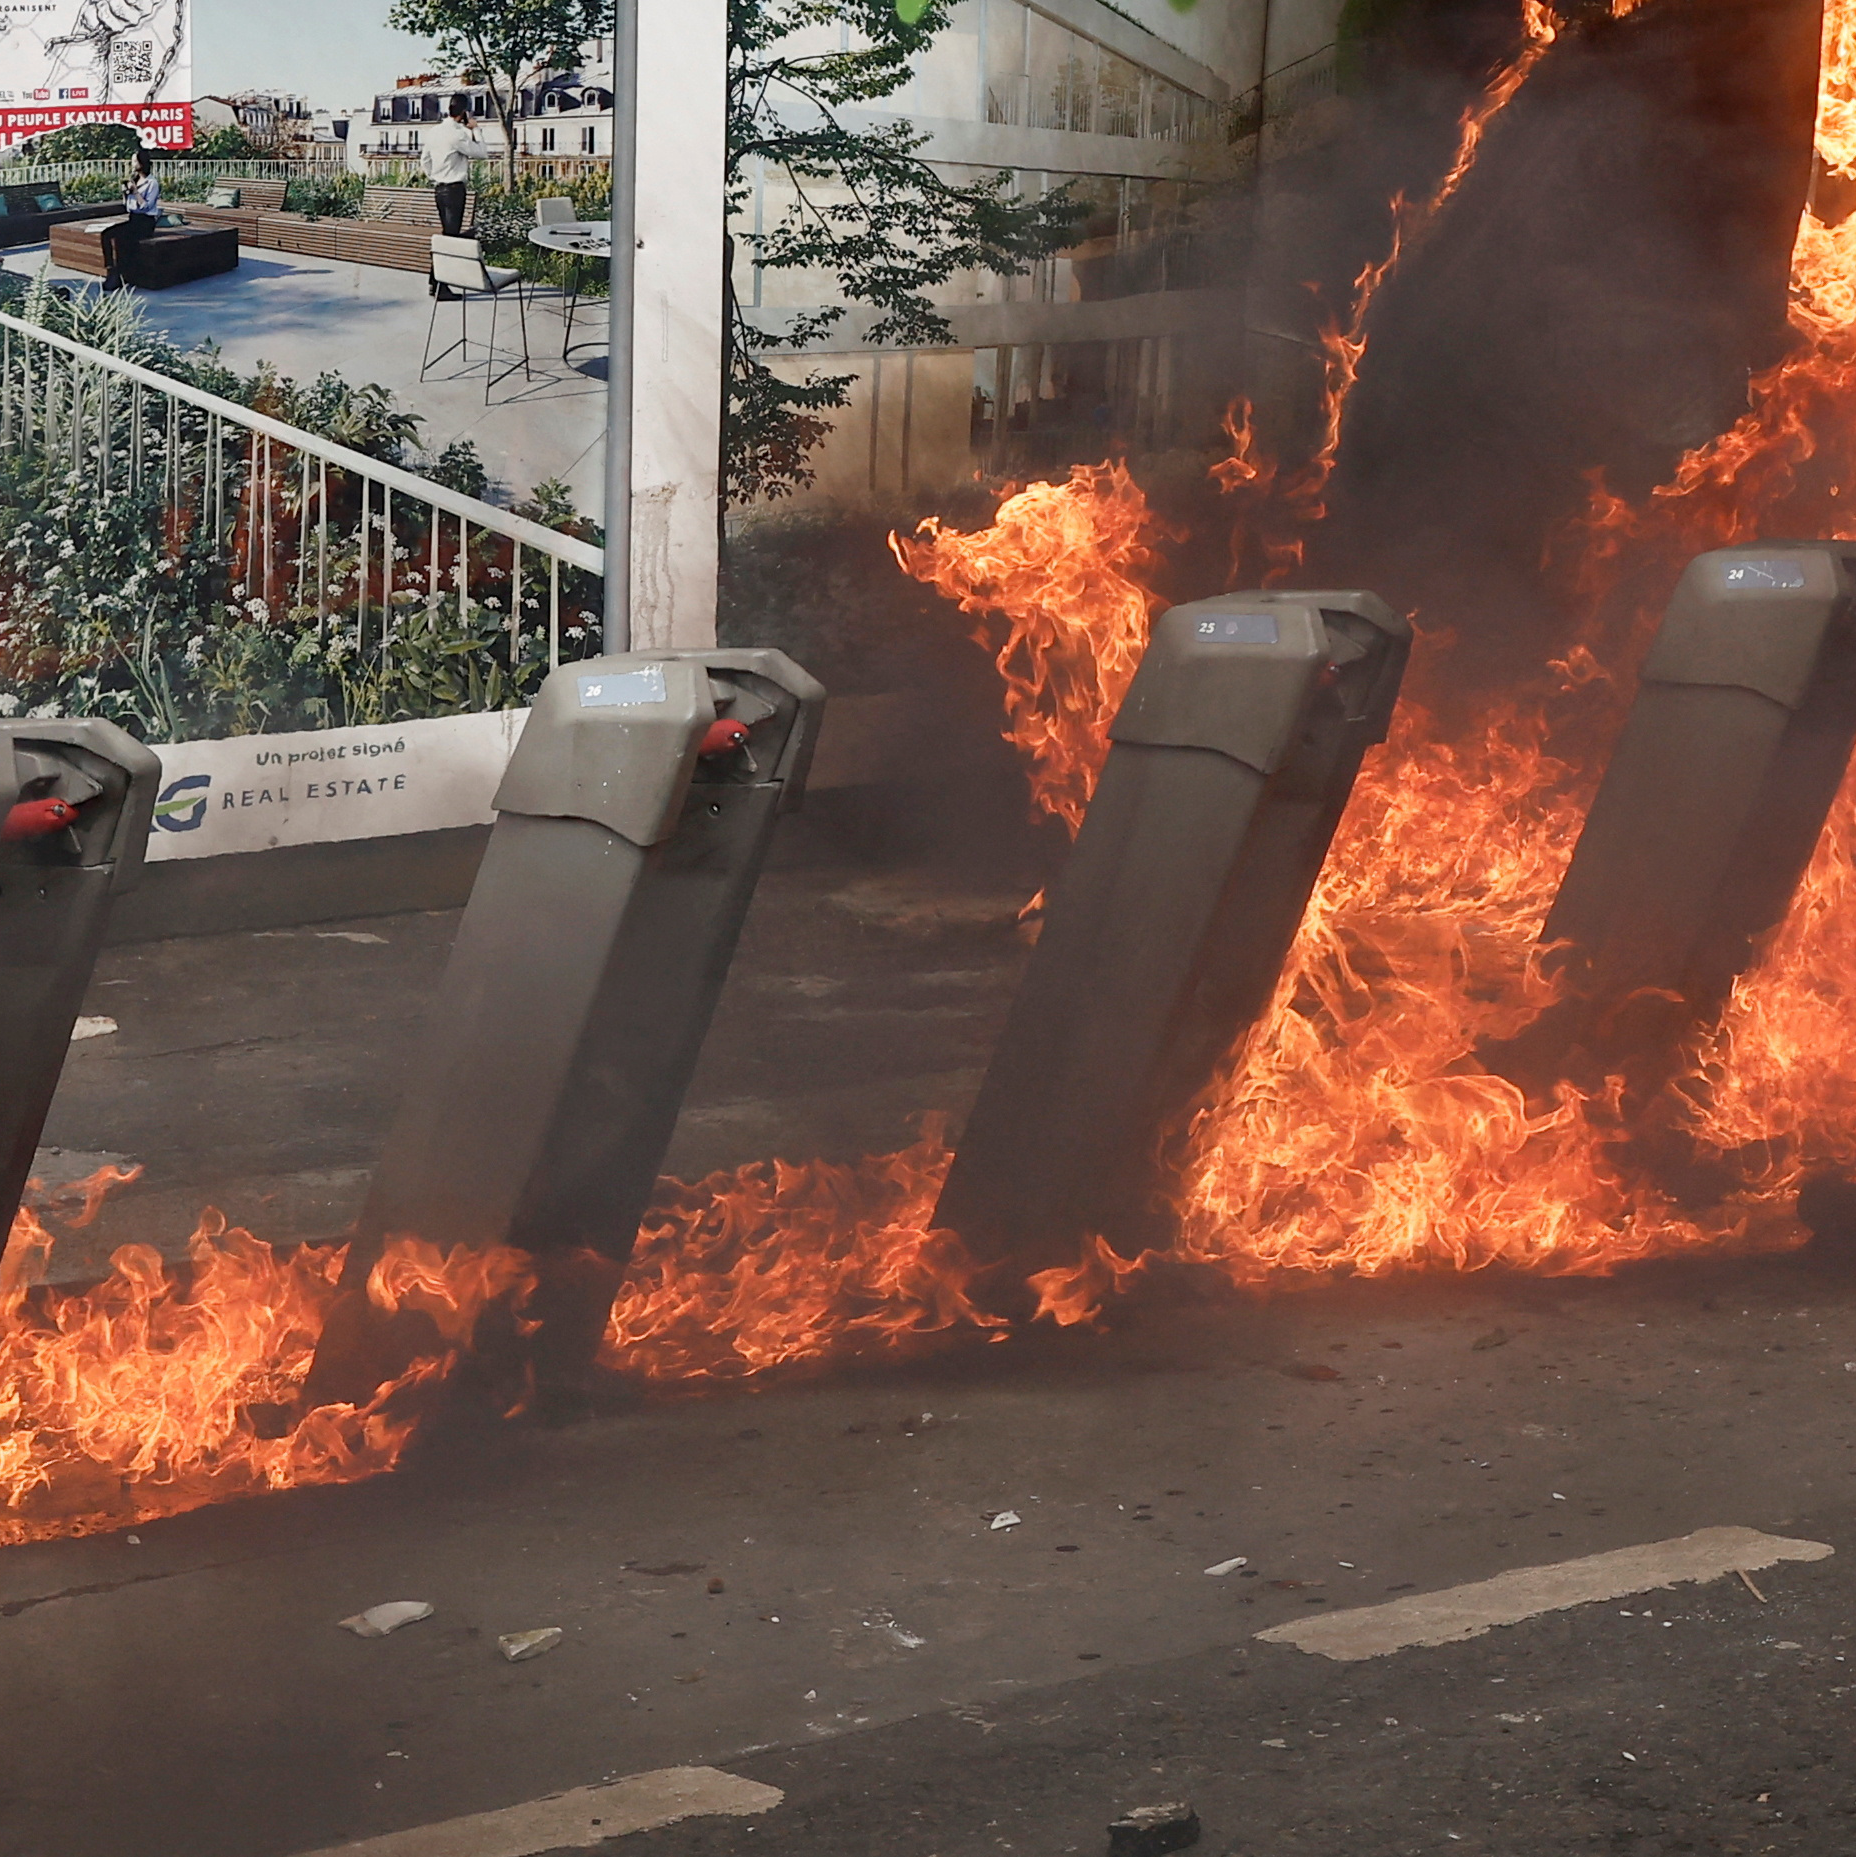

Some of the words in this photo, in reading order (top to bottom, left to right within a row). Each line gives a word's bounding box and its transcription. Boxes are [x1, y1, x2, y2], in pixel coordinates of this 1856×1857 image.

[7, 111, 61, 128] PEUPLE
[65, 109, 121, 126] KABYLE
[126, 109, 137, 122] A
[142, 107, 184, 123] PARIS
[1727, 569, 1745, 580] 24
[1198, 622, 1216, 634] 25
[585, 684, 603, 697] 26
[256, 751, 282, 766] Un
[288, 745, 347, 767] projet
[352, 737, 406, 757] signé
[222, 787, 290, 810] REAL
[306, 773, 407, 800] ESTATE
